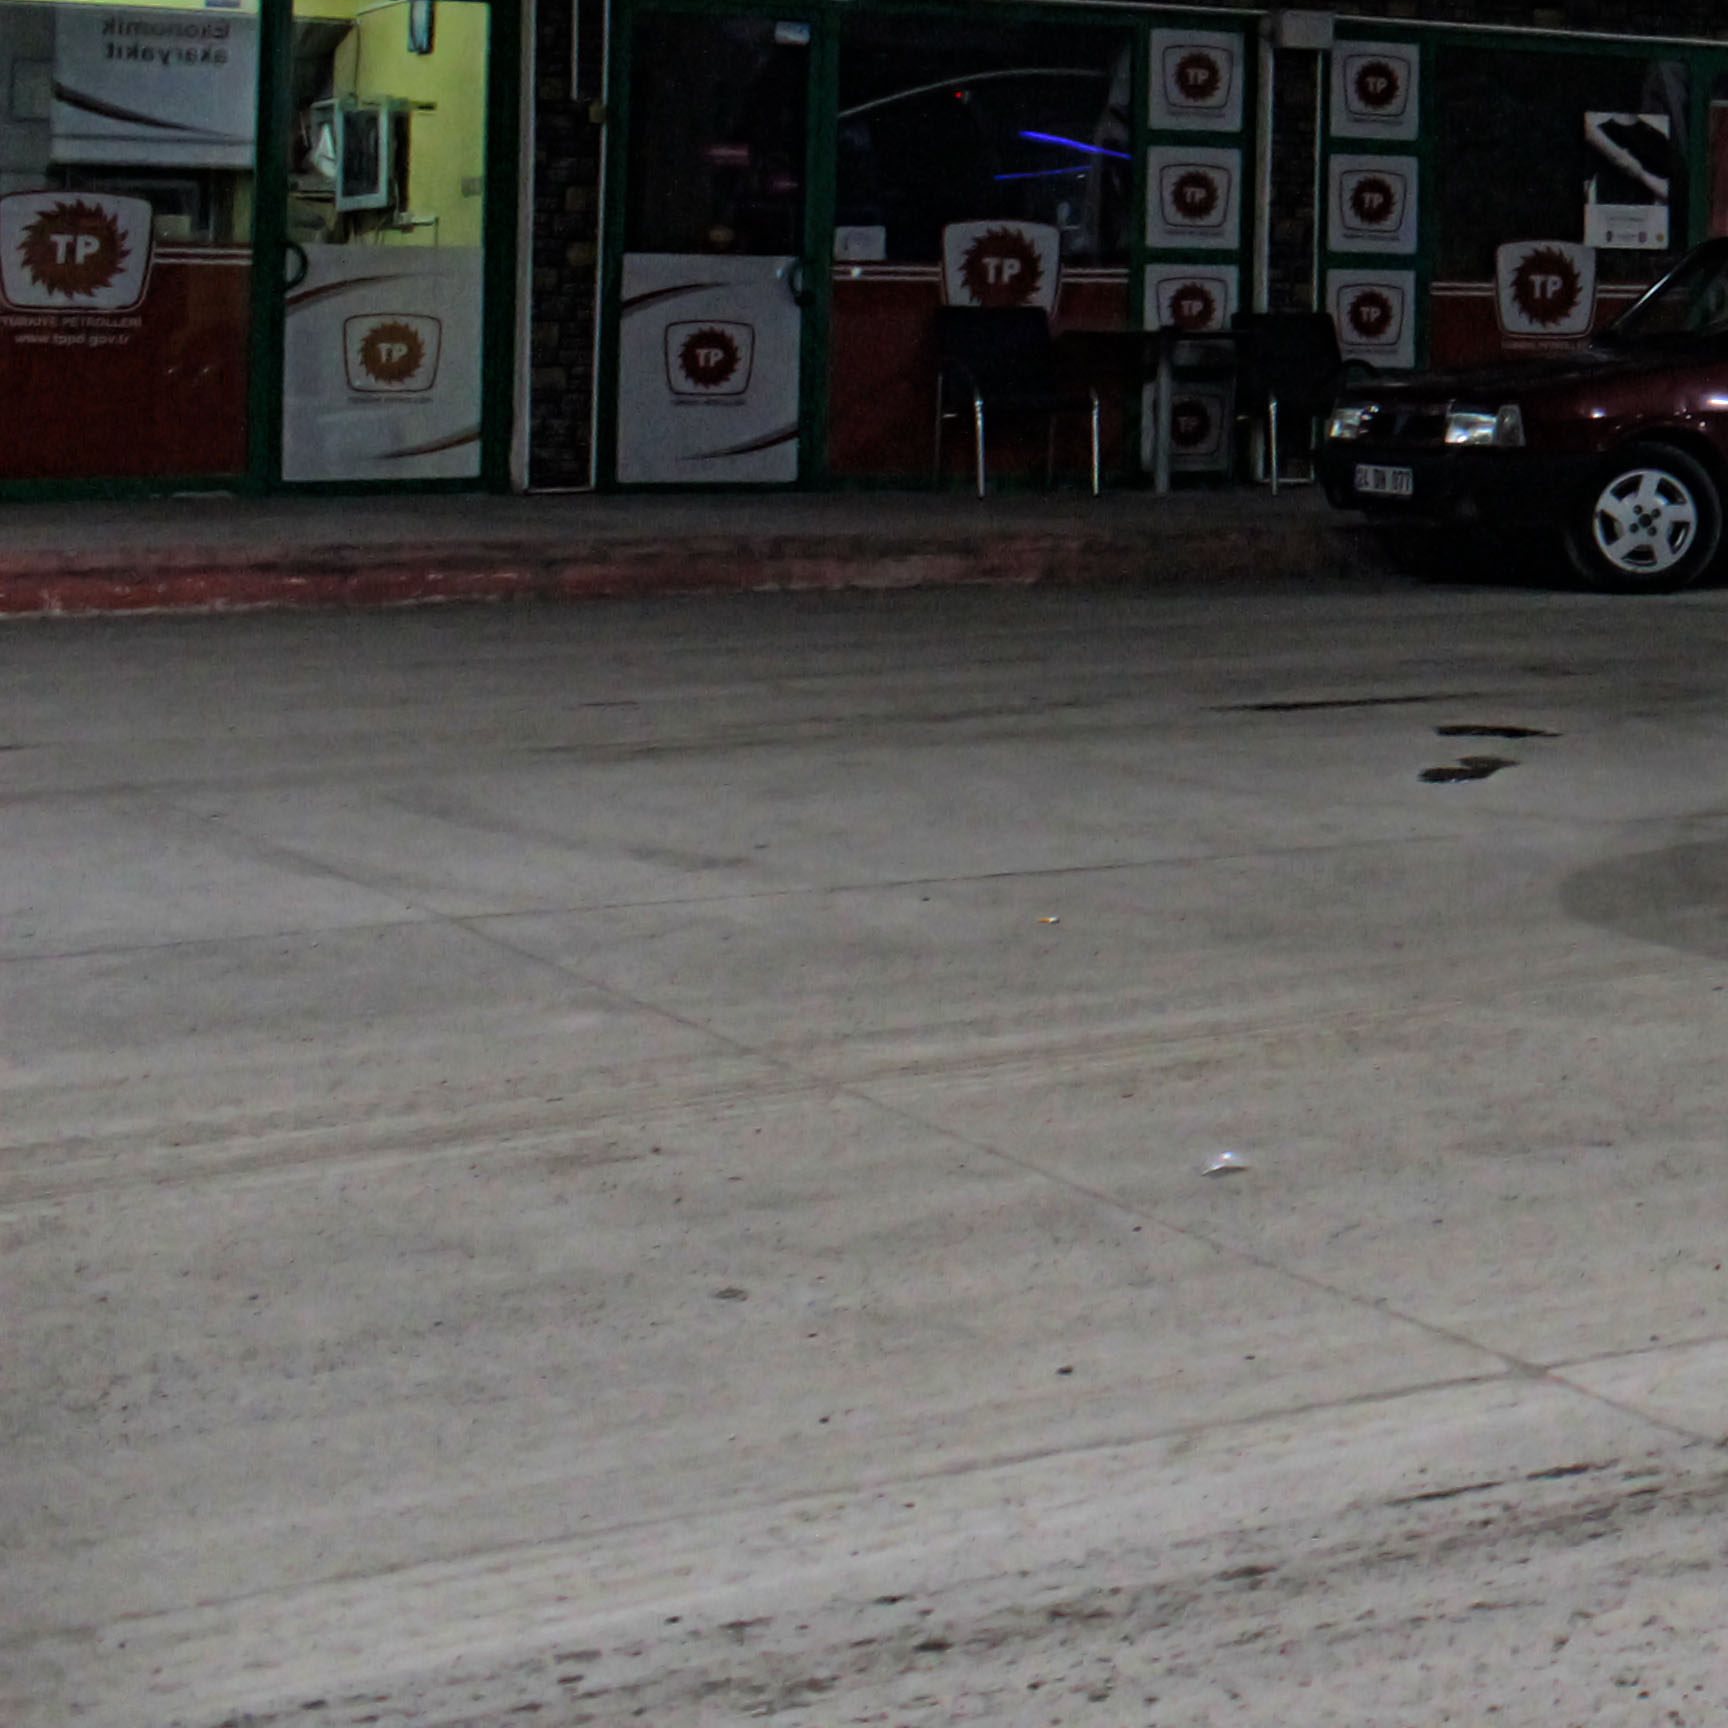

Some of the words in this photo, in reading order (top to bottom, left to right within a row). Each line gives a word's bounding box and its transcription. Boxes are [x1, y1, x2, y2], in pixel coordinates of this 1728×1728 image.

[1184, 67, 1209, 84] TP
[1364, 75, 1388, 92] TP
[1182, 186, 1207, 203] TP
[1361, 191, 1384, 209] TP
[49, 234, 101, 265] TP
[981, 256, 1022, 285] TP
[1528, 273, 1564, 300] TP
[1180, 300, 1204, 317] TP
[1359, 306, 1382, 324] TP
[376, 343, 409, 364] TP
[695, 348, 726, 368] TP
